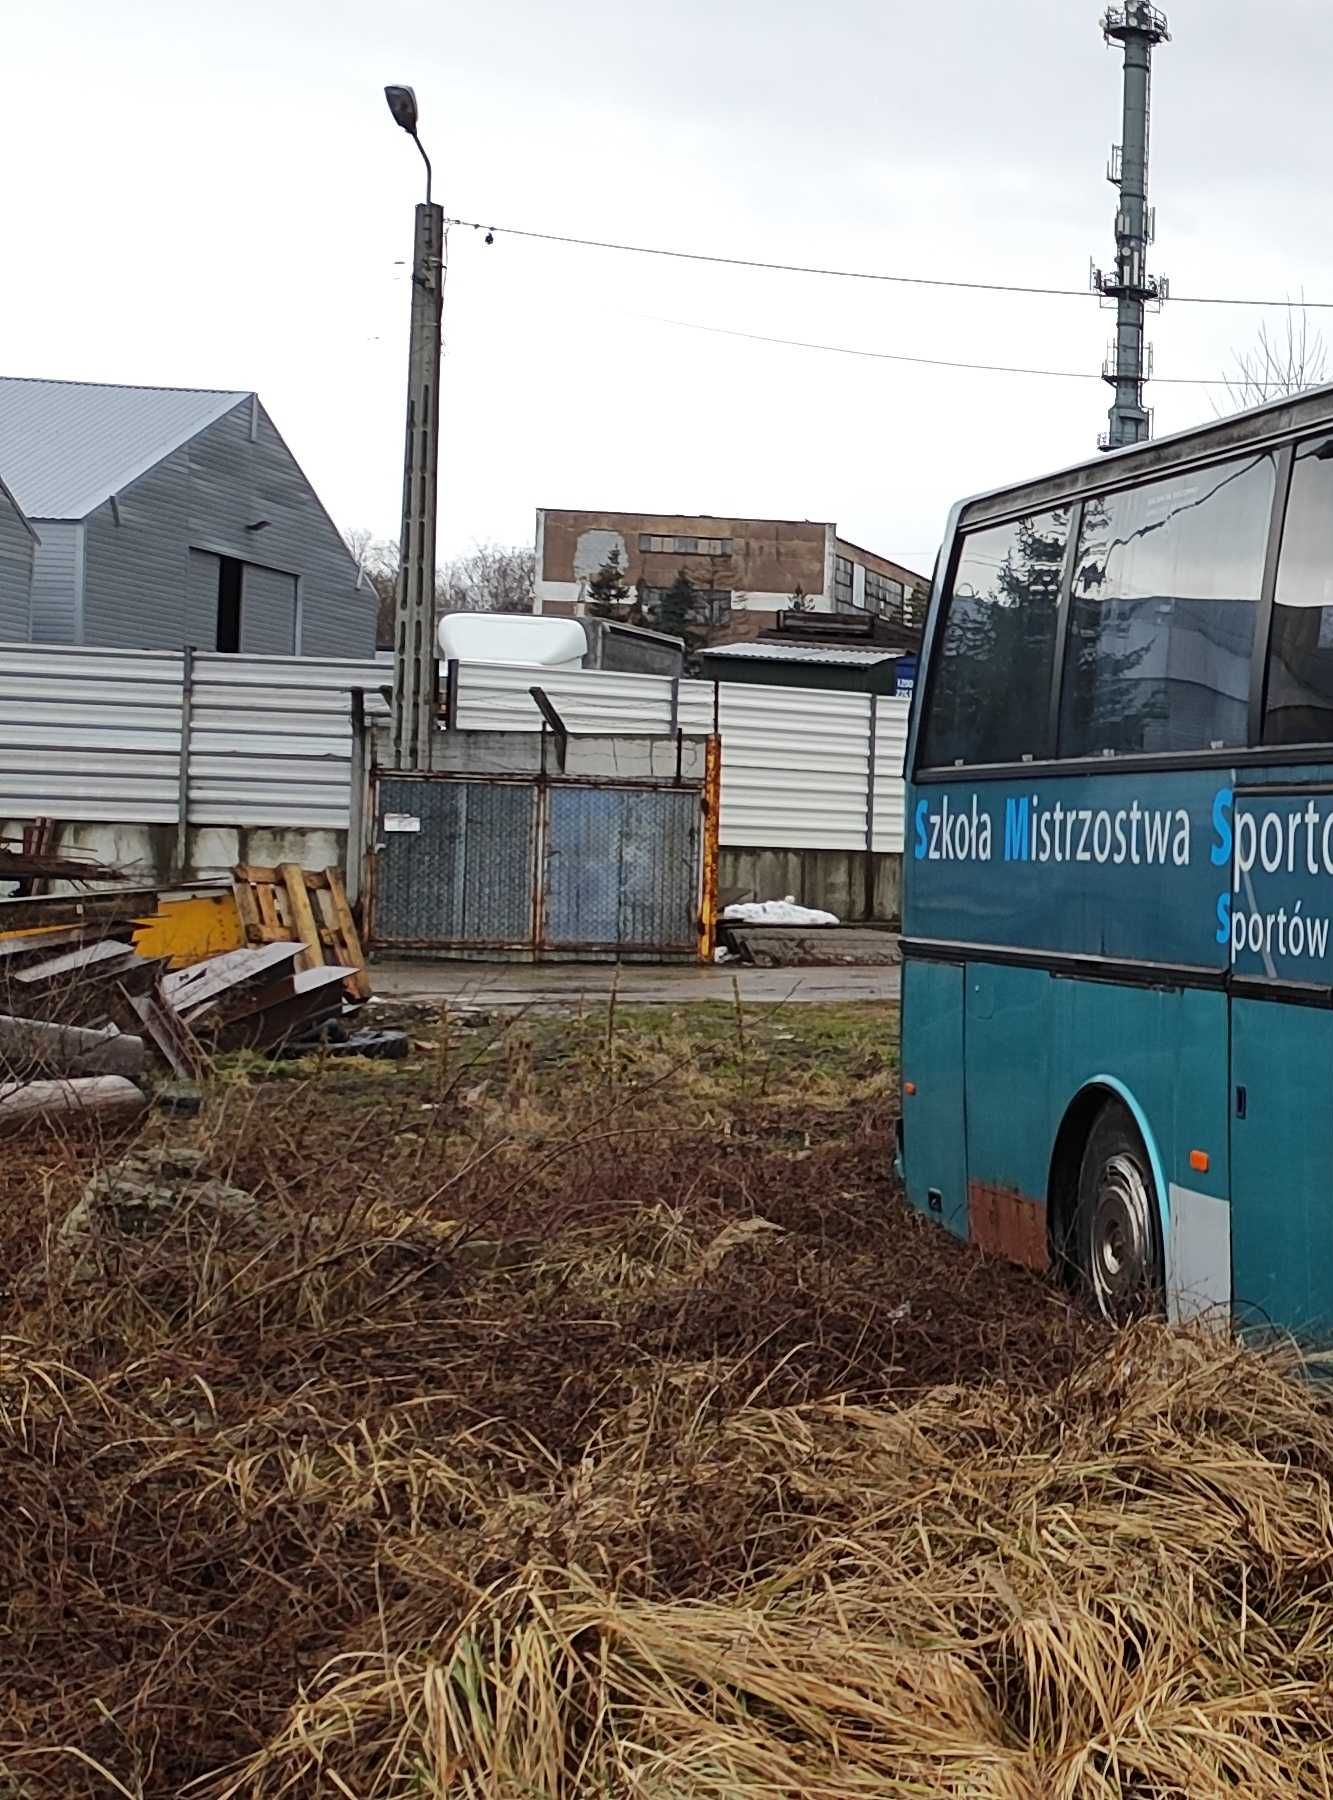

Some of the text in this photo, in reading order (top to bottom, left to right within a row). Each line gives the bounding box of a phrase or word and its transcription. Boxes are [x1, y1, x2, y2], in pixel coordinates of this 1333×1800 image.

[914, 793, 992, 861] Szkoła
[1004, 794, 1191, 866] Mistrzostwa
[1216, 892, 1329, 964] Sportów
